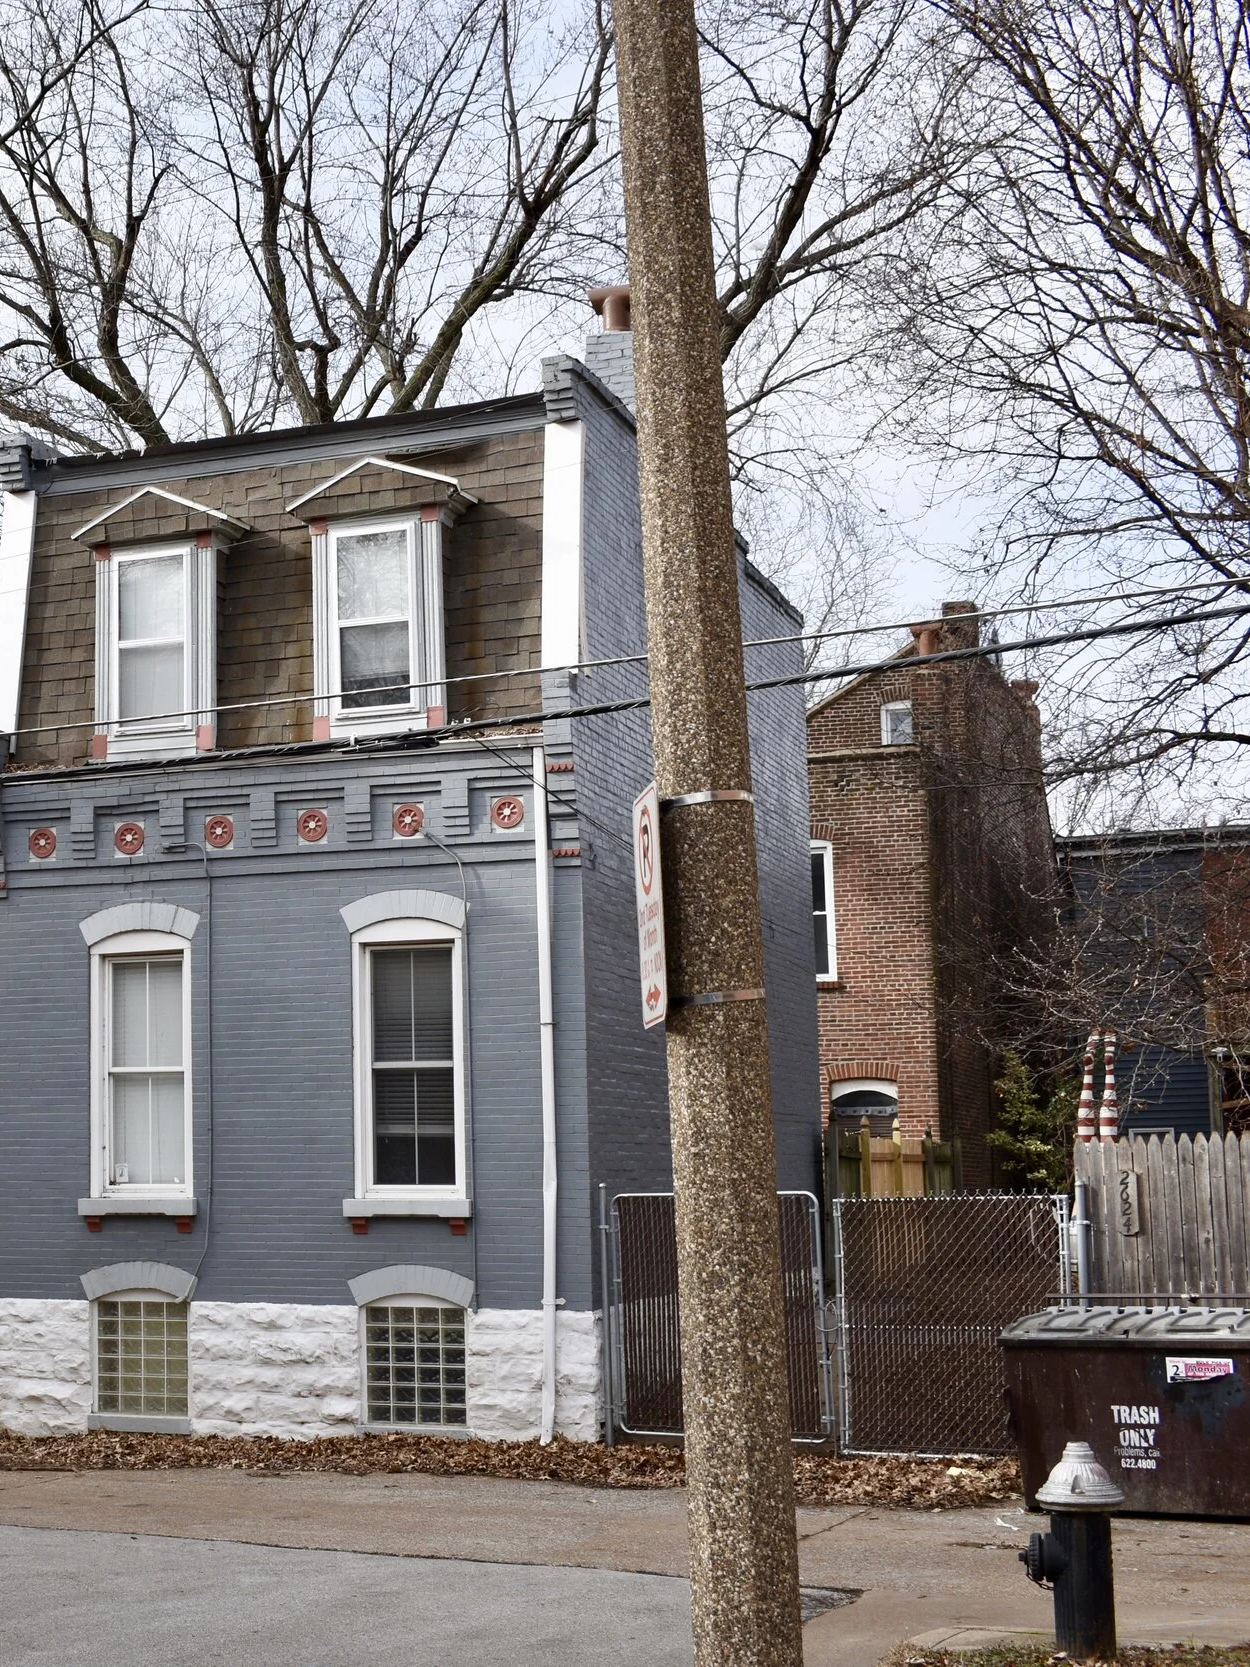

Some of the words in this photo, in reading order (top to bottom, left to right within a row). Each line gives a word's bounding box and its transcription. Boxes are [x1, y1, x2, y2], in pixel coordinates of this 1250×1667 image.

[1119, 1170, 1132, 1234] 2624
[1188, 1365, 1227, 1373] Monday
[1111, 1405, 1160, 1424] TRASH
[1119, 1427, 1155, 1447] ONLY
[1121, 1458, 1156, 1469] 622.4800
